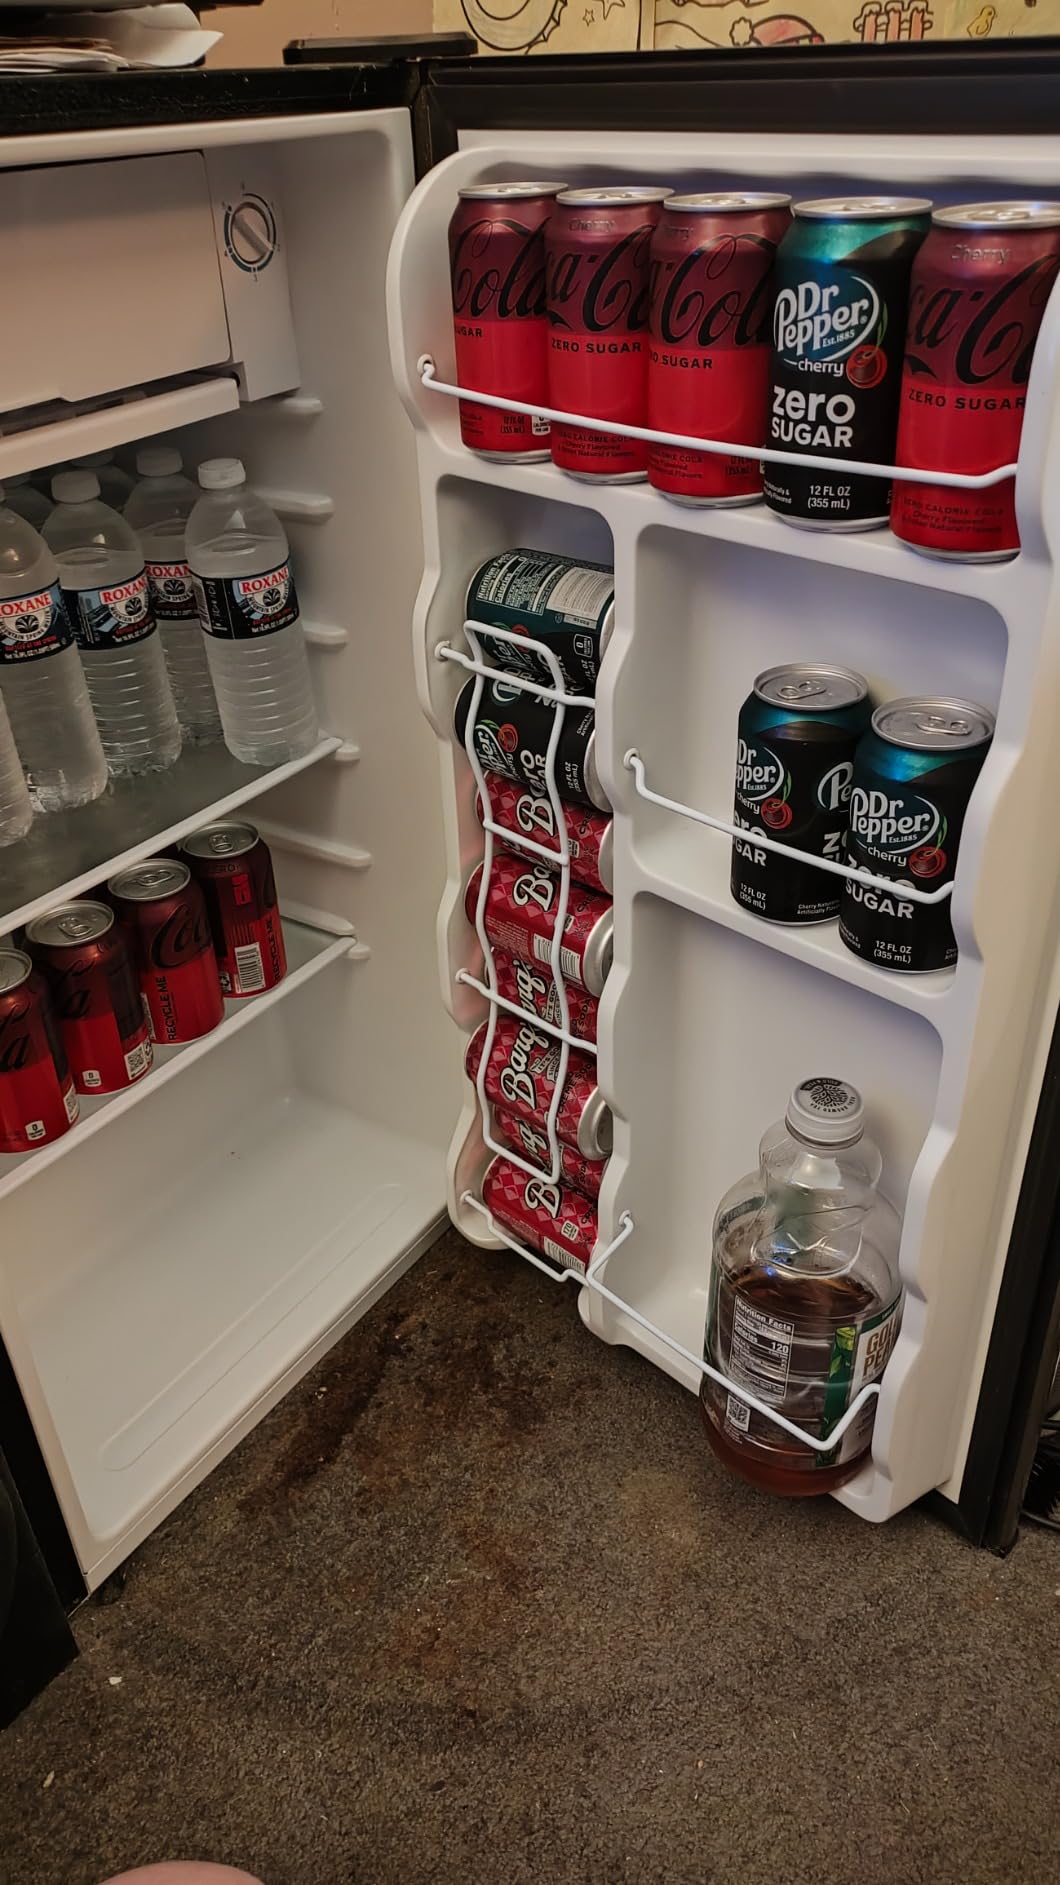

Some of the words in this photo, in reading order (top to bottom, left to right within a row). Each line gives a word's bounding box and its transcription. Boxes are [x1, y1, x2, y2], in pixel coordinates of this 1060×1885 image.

[797, 281, 840, 321] Dr
[456, 326, 482, 337] GAR
[773, 288, 869, 356] Pepper
[551, 338, 579, 352] ZERO
[586, 342, 641, 353] SUGAR
[822, 329, 855, 347] Est.1885
[662, 355, 712, 369] SUGAR
[798, 358, 844, 377] cherry
[773, 385, 855, 424] zero
[909, 389, 946, 407] ZERO
[955, 396, 1025, 410] SUGAR
[771, 416, 853, 447] SUGAR
[809, 485, 822, 495] 12
[823, 486, 835, 496] FL
[837, 487, 851, 496] OZ
[807, 497, 829, 509] (355
[830, 499, 850, 510] mL)
[477, 564, 497, 599] Nutrition
[494, 572, 512, 603] Calories
[737, 738, 757, 765] Dr
[736, 764, 777, 790] pper
[850, 787, 931, 843] Pepper
[868, 790, 905, 818] Dr
[735, 839, 767, 867] GAR
[867, 845, 907, 867] cherry
[739, 891, 753, 905] (355
[753, 897, 766, 910] mL)
[740, 883, 748, 892] 12
[748, 887, 756, 896] FL
[756, 890, 767, 901] OZ
[845, 879, 915, 919] SUGAR
[798, 902, 816, 910] Cherry
[873, 948, 892, 960] (355
[893, 952, 912, 964] mL)
[875, 940, 886, 949] 12
[887, 942, 897, 951] FL
[900, 945, 912, 954] OZ
[156, 976, 168, 992] ME
[159, 993, 177, 1040] RECYCLE
[559, 1080, 577, 1114] CREME
[563, 1222, 572, 1234] 170
[736, 1297, 767, 1323] Nutrition
[767, 1317, 792, 1331] Facts
[734, 1322, 758, 1343] Calories
[771, 1341, 789, 1354] 120
